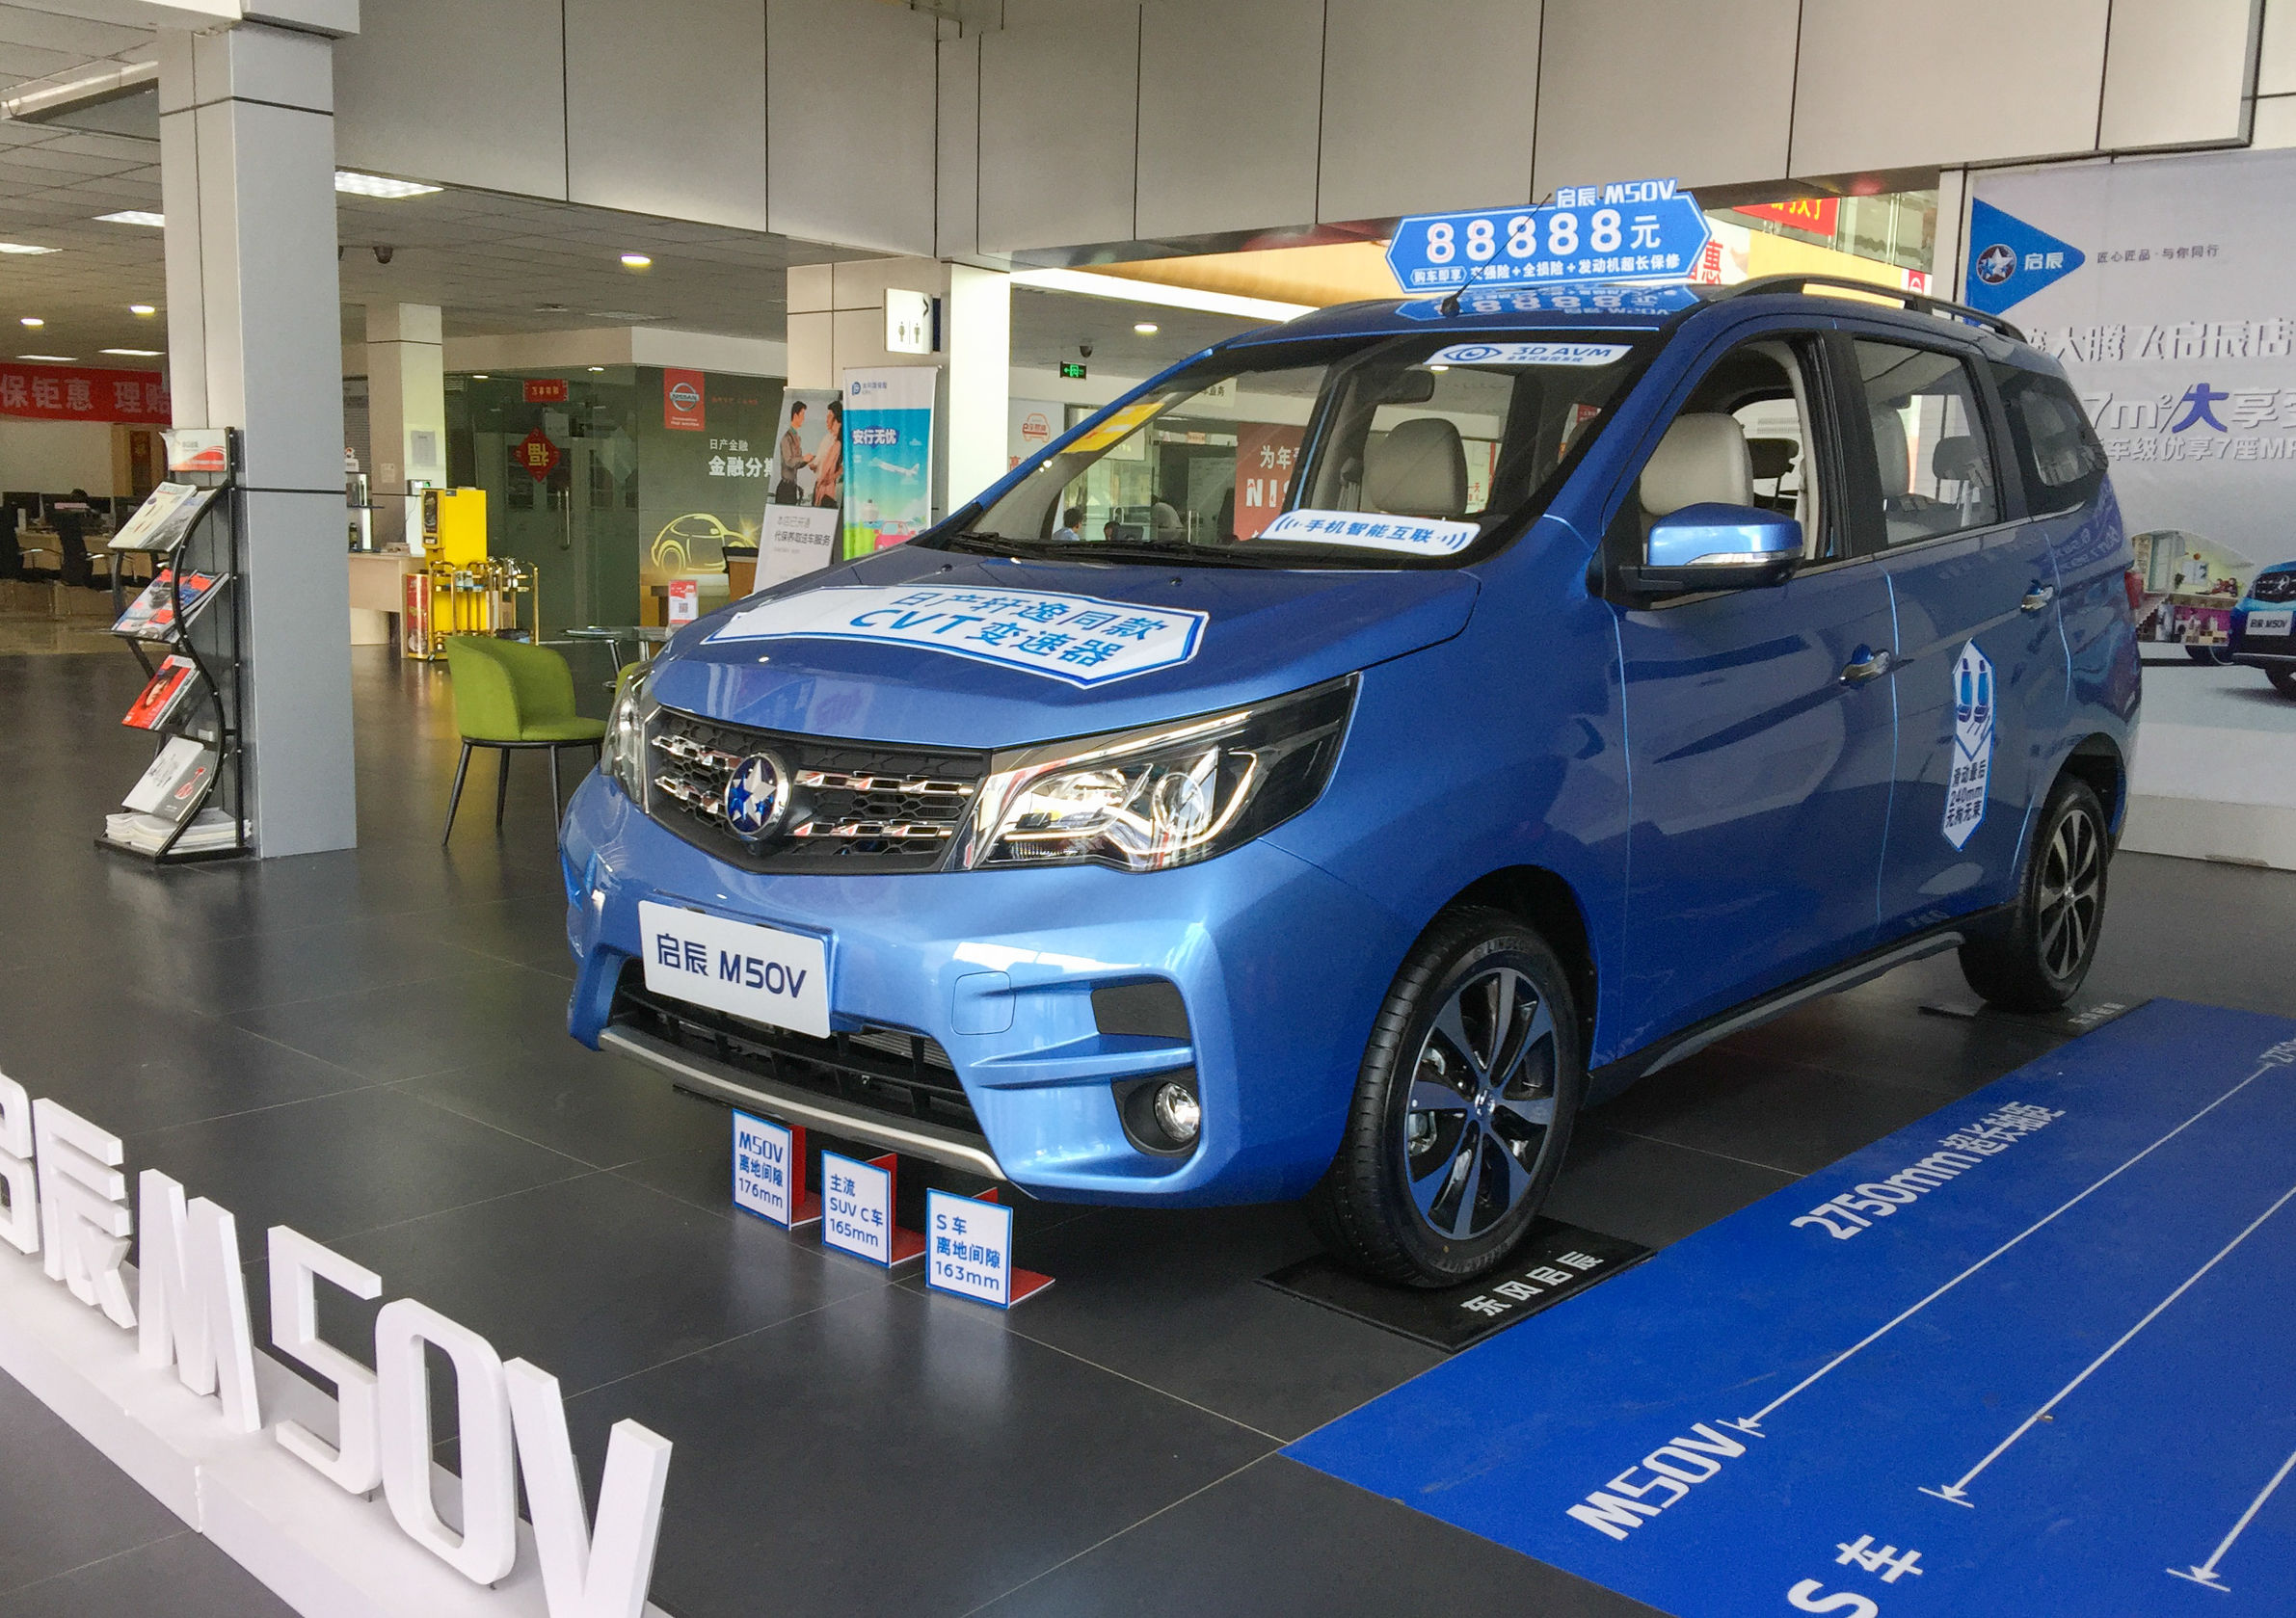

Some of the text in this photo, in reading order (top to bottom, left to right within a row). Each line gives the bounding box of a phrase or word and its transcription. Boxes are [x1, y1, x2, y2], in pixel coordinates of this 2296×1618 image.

[1557, 180, 1676, 208] 启辰 M50V
[2024, 252, 2064, 271] 启辰
[1512, 347, 1612, 357] 3D AVM
[709, 439, 748, 452] 日产金融
[852, 429, 896, 445] 安行无忧
[1305, 519, 1434, 544] 手机智能互联
[890, 592, 1168, 642] 日产轩逸同款
[656, 933, 807, 998] 启辰 M50V
[738, 1130, 783, 1163] M50V
[738, 1154, 783, 1188] 离地间隙
[738, 1177, 783, 1208] 176mm
[830, 1175, 855, 1197] 主流
[830, 1198, 857, 1216] SUV
[830, 1219, 878, 1247] 165mm
[936, 1214, 967, 1235] S 车
[936, 1235, 1001, 1269] 离地间隙
[935, 1261, 1000, 1291] 163mm
[1460, 1251, 1604, 1316] 东风启辰
[1565, 1422, 1747, 1541] M50V
[1835, 1534, 1923, 1583] 车
